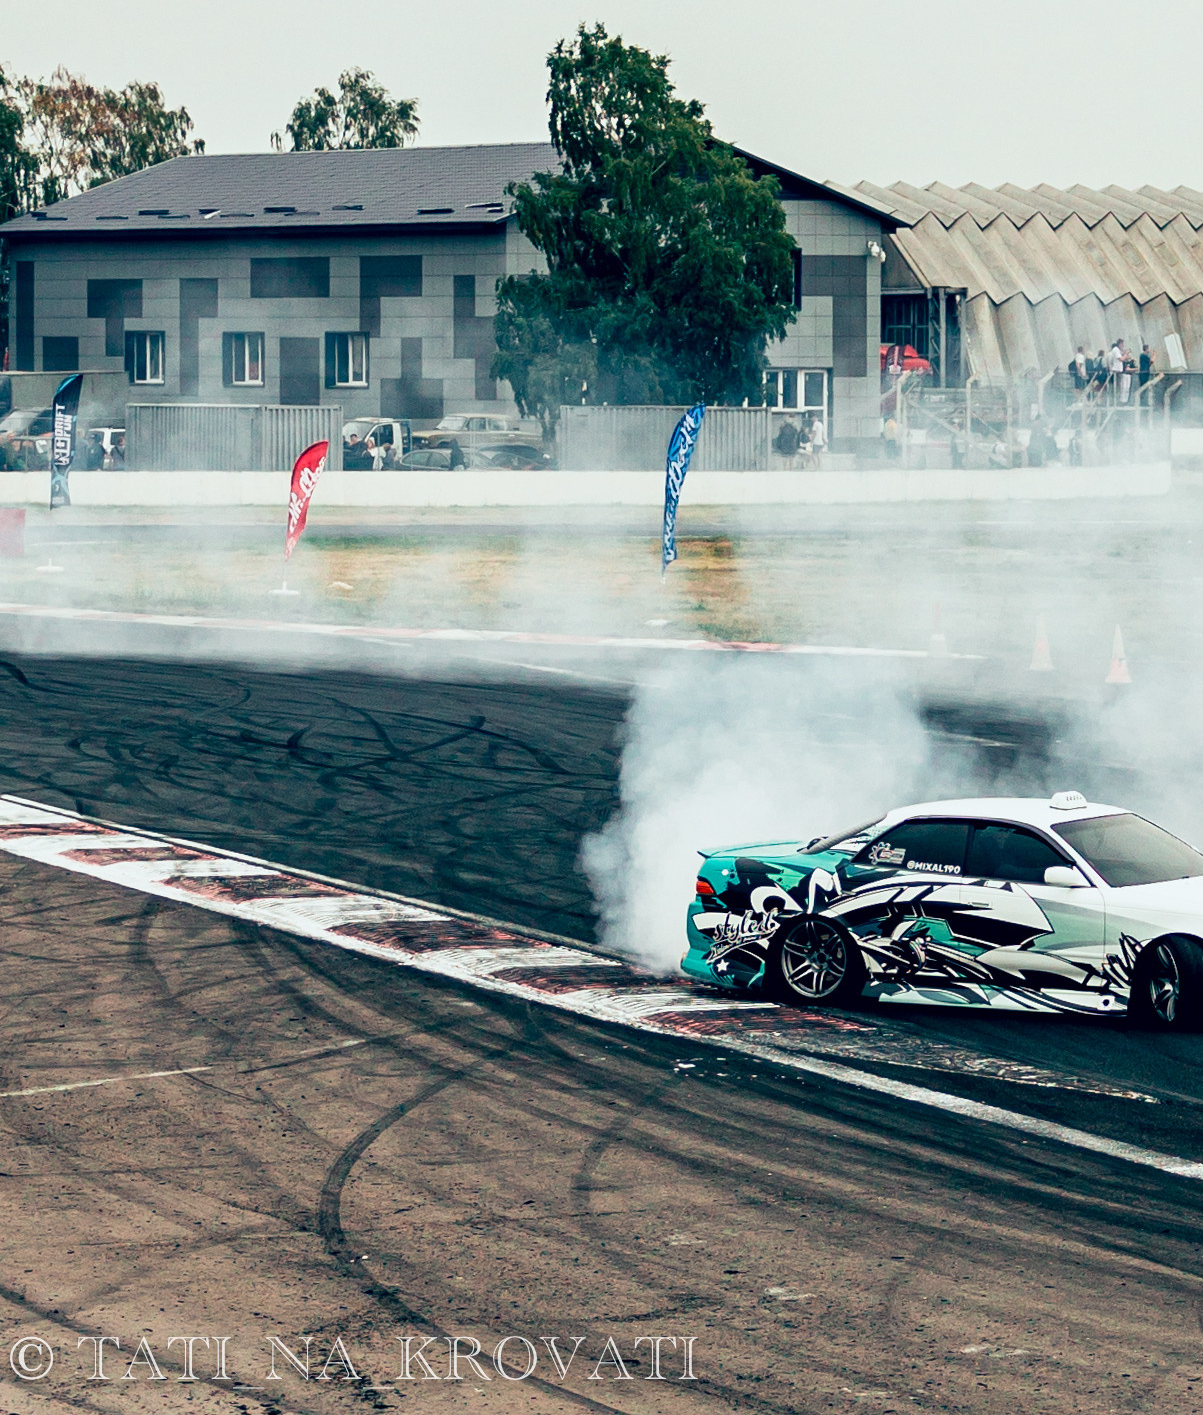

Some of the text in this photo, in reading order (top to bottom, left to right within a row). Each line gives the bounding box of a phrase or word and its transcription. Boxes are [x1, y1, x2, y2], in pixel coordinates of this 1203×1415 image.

[55, 403, 66, 436] DRIFT
[63, 414, 73, 437] FUN
[906, 860, 961, 875] @MIXAL190
